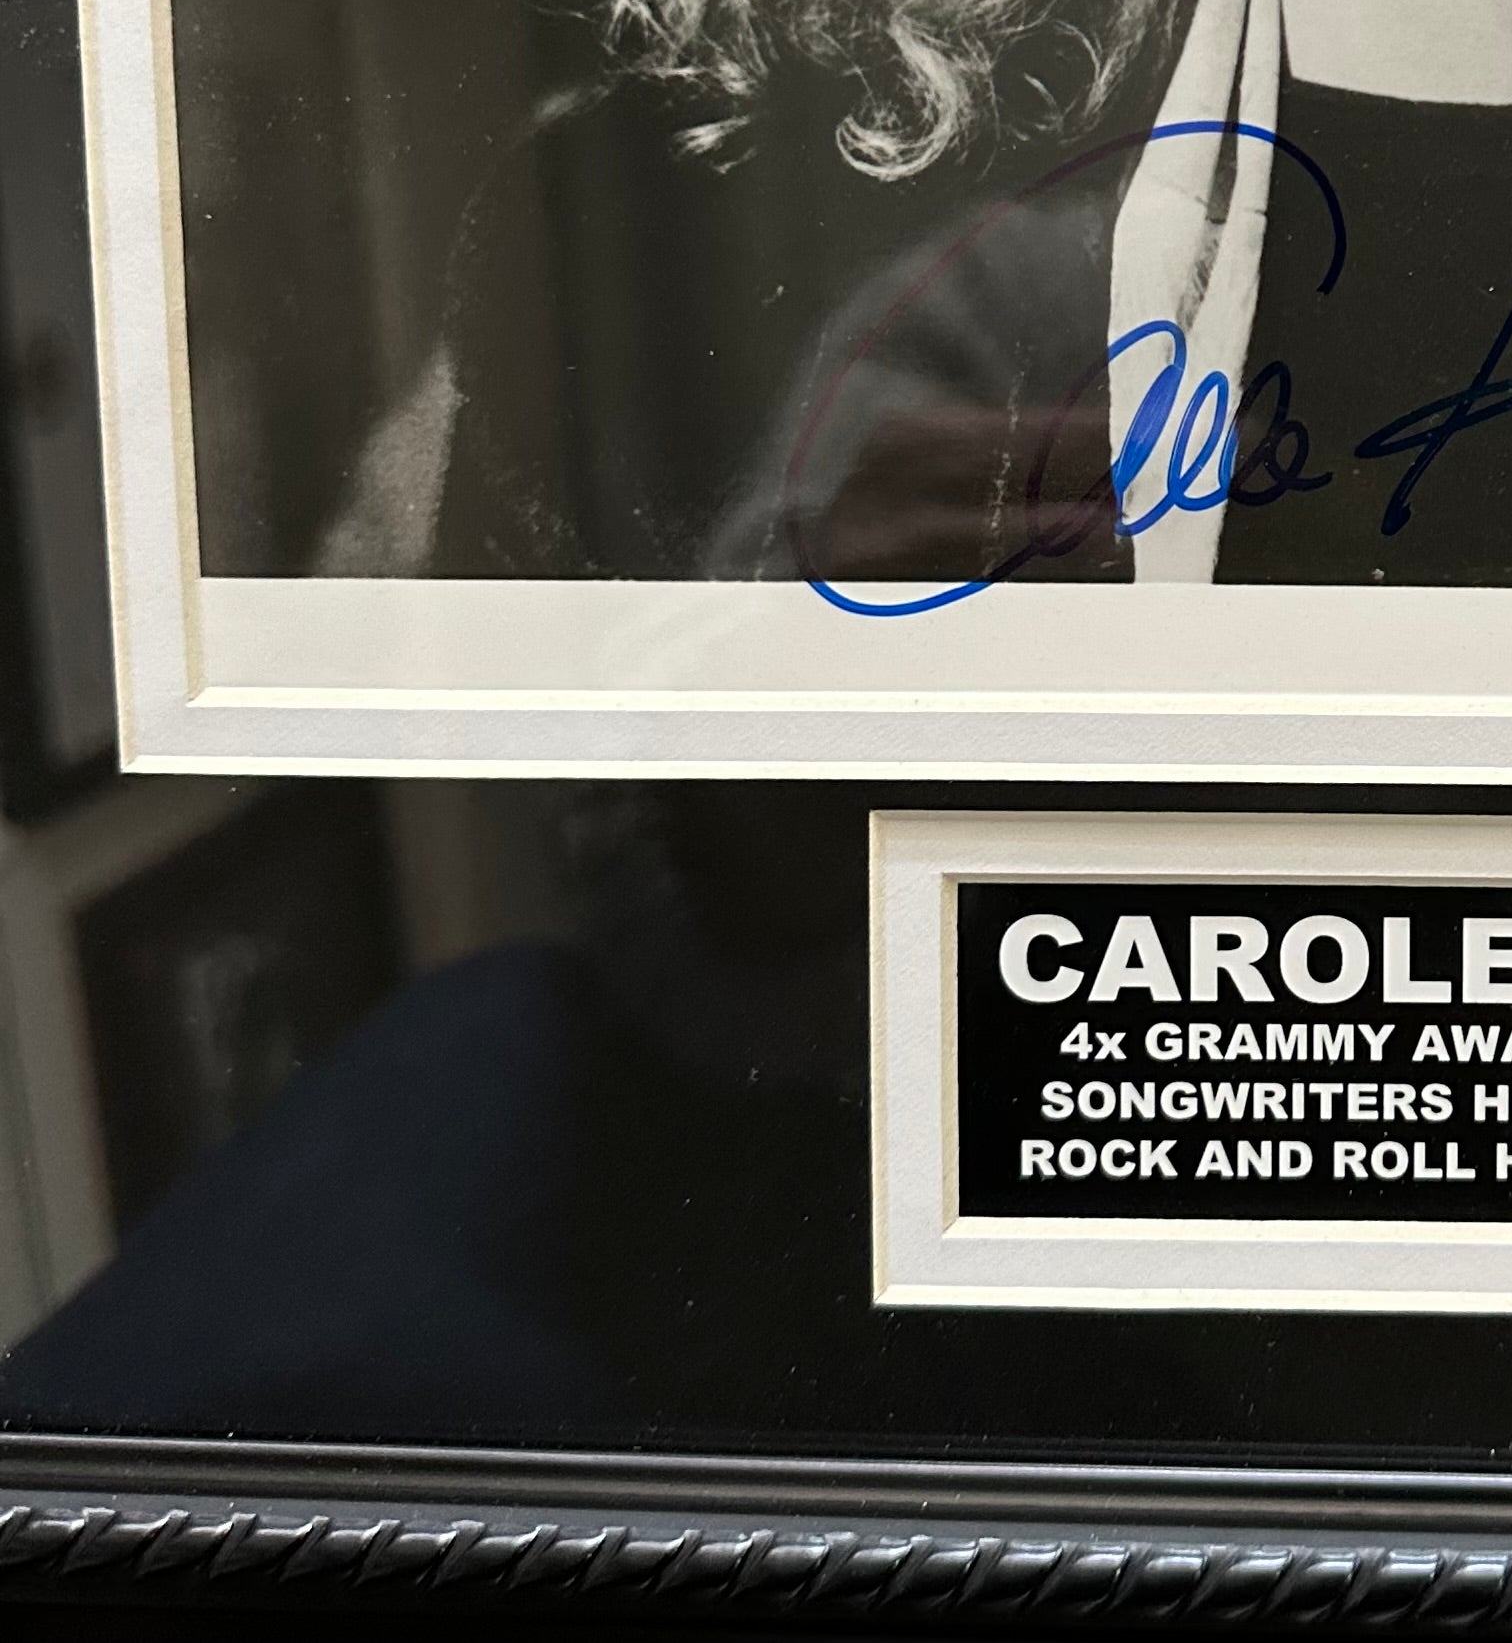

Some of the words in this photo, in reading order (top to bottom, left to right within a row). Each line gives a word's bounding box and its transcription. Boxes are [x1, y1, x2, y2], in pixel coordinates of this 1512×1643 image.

[1059, 1020, 1127, 1061] 4x
[1143, 1021, 1397, 1063] GRAMMY
[1039, 1079, 1455, 1123] SONGWRITERS
[1019, 1137, 1180, 1179] ROCK
[1193, 1139, 1314, 1179] AND
[1332, 1139, 1477, 1181] ROLL
